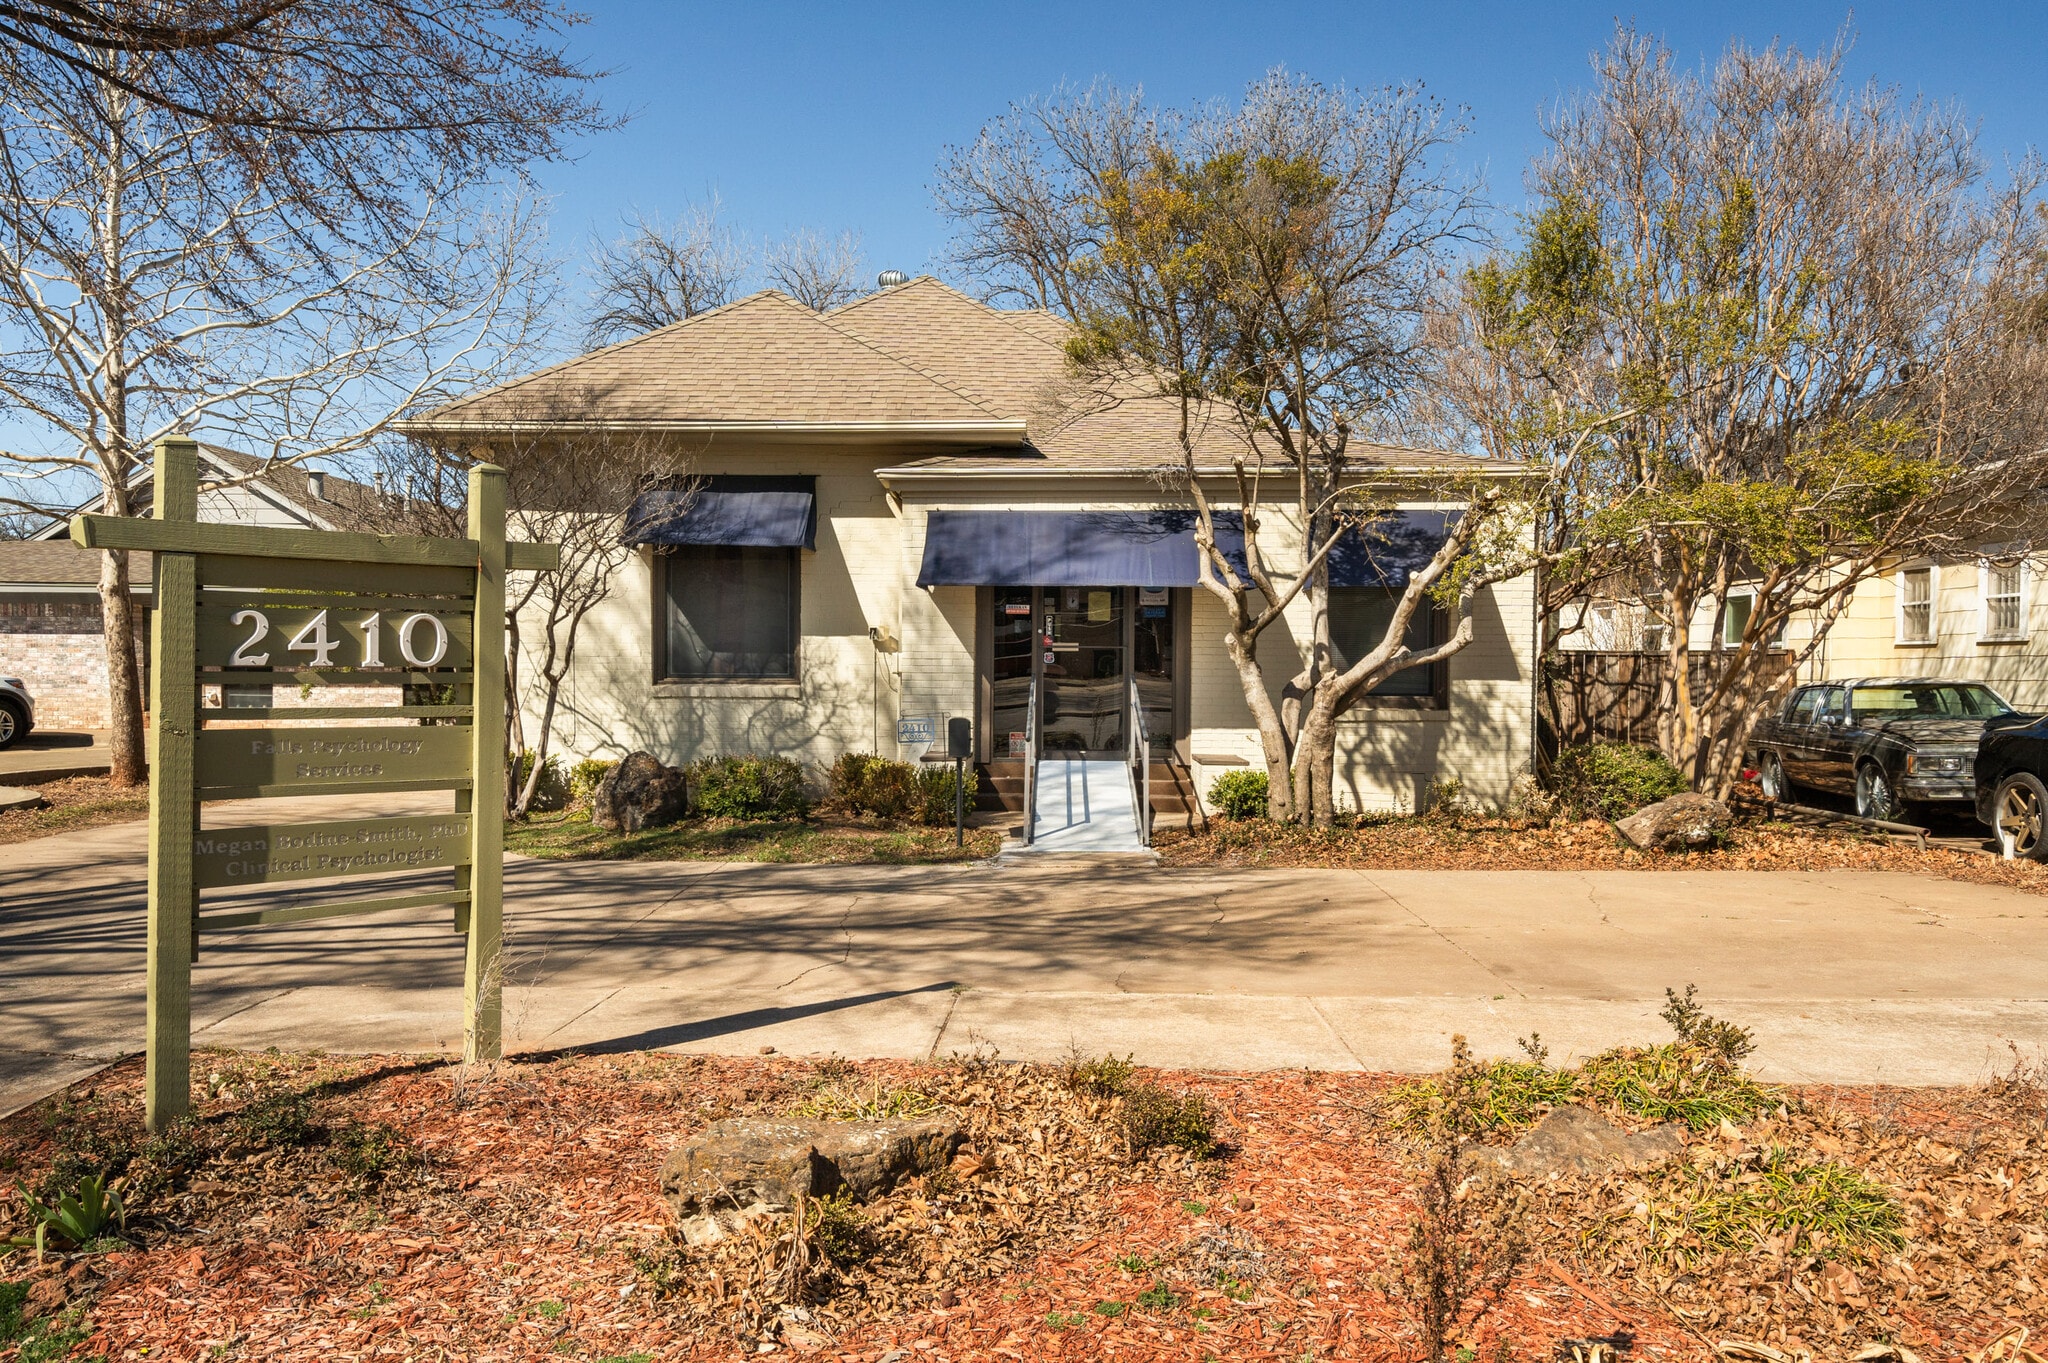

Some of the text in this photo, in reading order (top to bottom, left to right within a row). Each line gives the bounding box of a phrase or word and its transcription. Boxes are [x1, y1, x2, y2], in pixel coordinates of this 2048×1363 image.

[230, 609, 448, 667] 2410
[902, 724, 930, 733] 2410
[251, 738, 424, 757] Falls Psychology
[296, 762, 383, 778] Services
[195, 823, 468, 856] Megan Bodine-Smith, PhD
[225, 846, 443, 876] Clinical Psychologist
